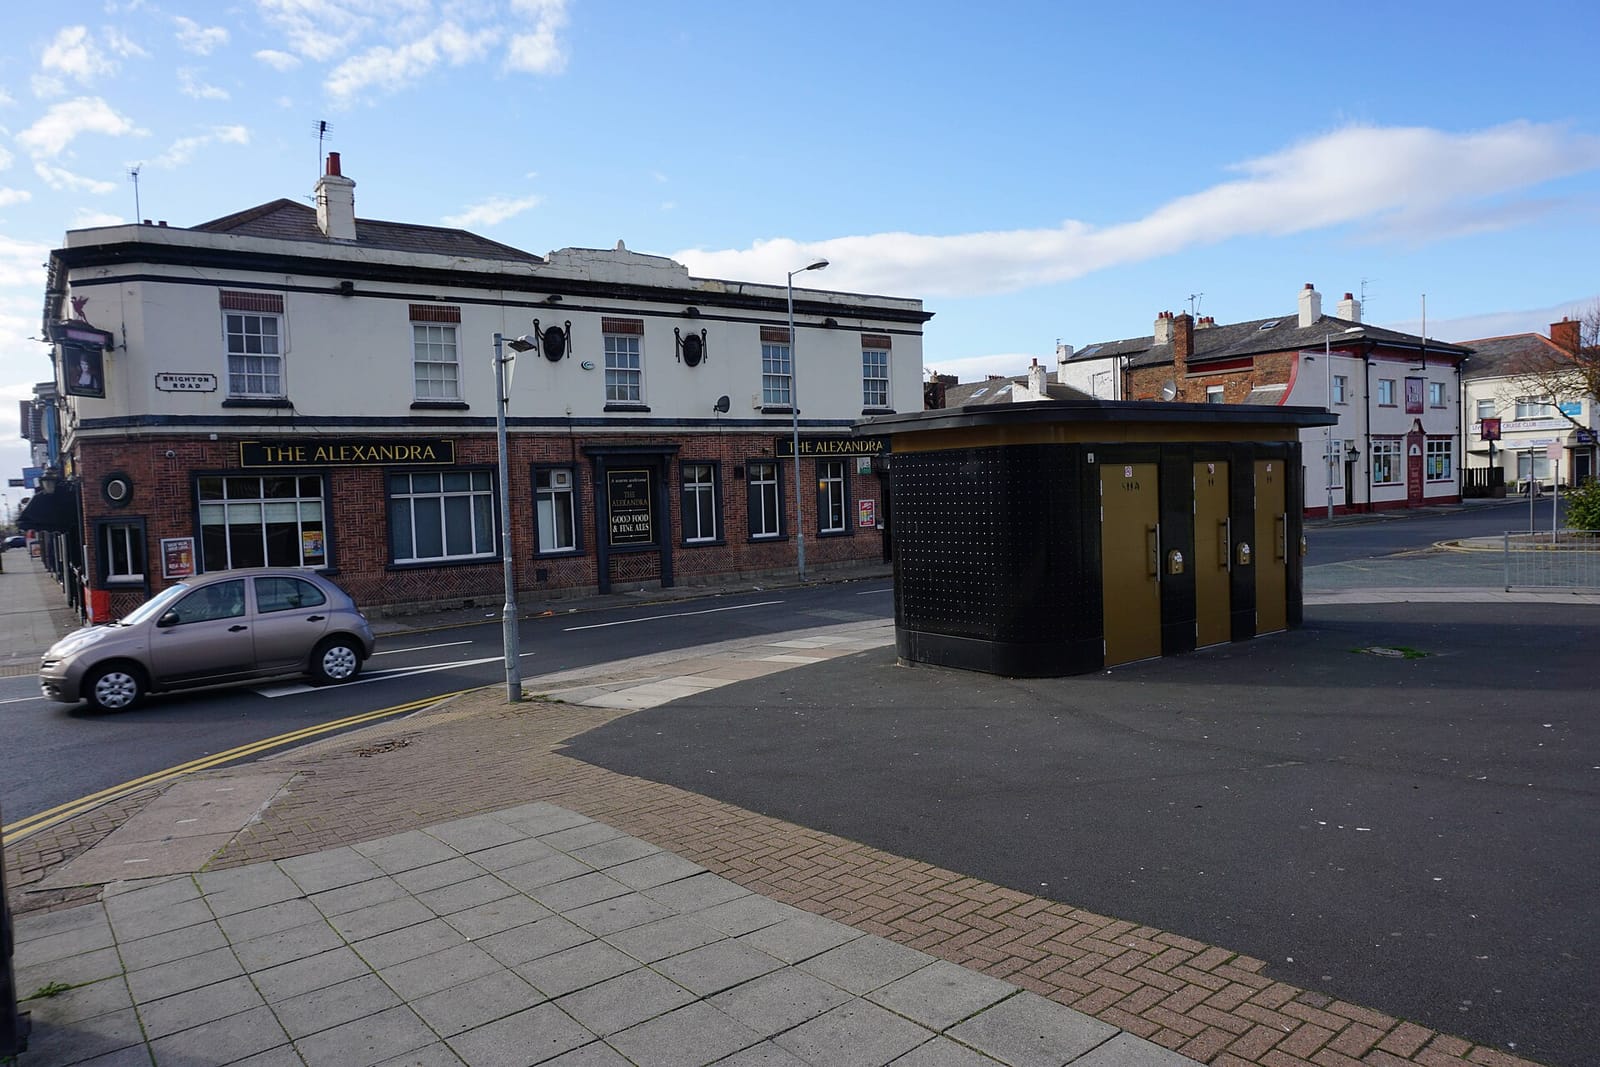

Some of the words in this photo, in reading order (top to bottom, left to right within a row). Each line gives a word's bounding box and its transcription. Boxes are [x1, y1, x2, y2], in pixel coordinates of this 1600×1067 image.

[787, 441, 813, 453] THE
[815, 440, 883, 453] ALEXANDRA
[262, 446, 307, 462] THE
[314, 445, 436, 461] ALEXANDRA
[624, 490, 636, 498] THE
[612, 499, 648, 507] ALEXANDRA
[612, 515, 631, 523] GOOD
[631, 514, 649, 522] FOOD
[612, 525, 618, 533] &
[619, 524, 634, 533] FINE
[635, 523, 649, 531] ALES
